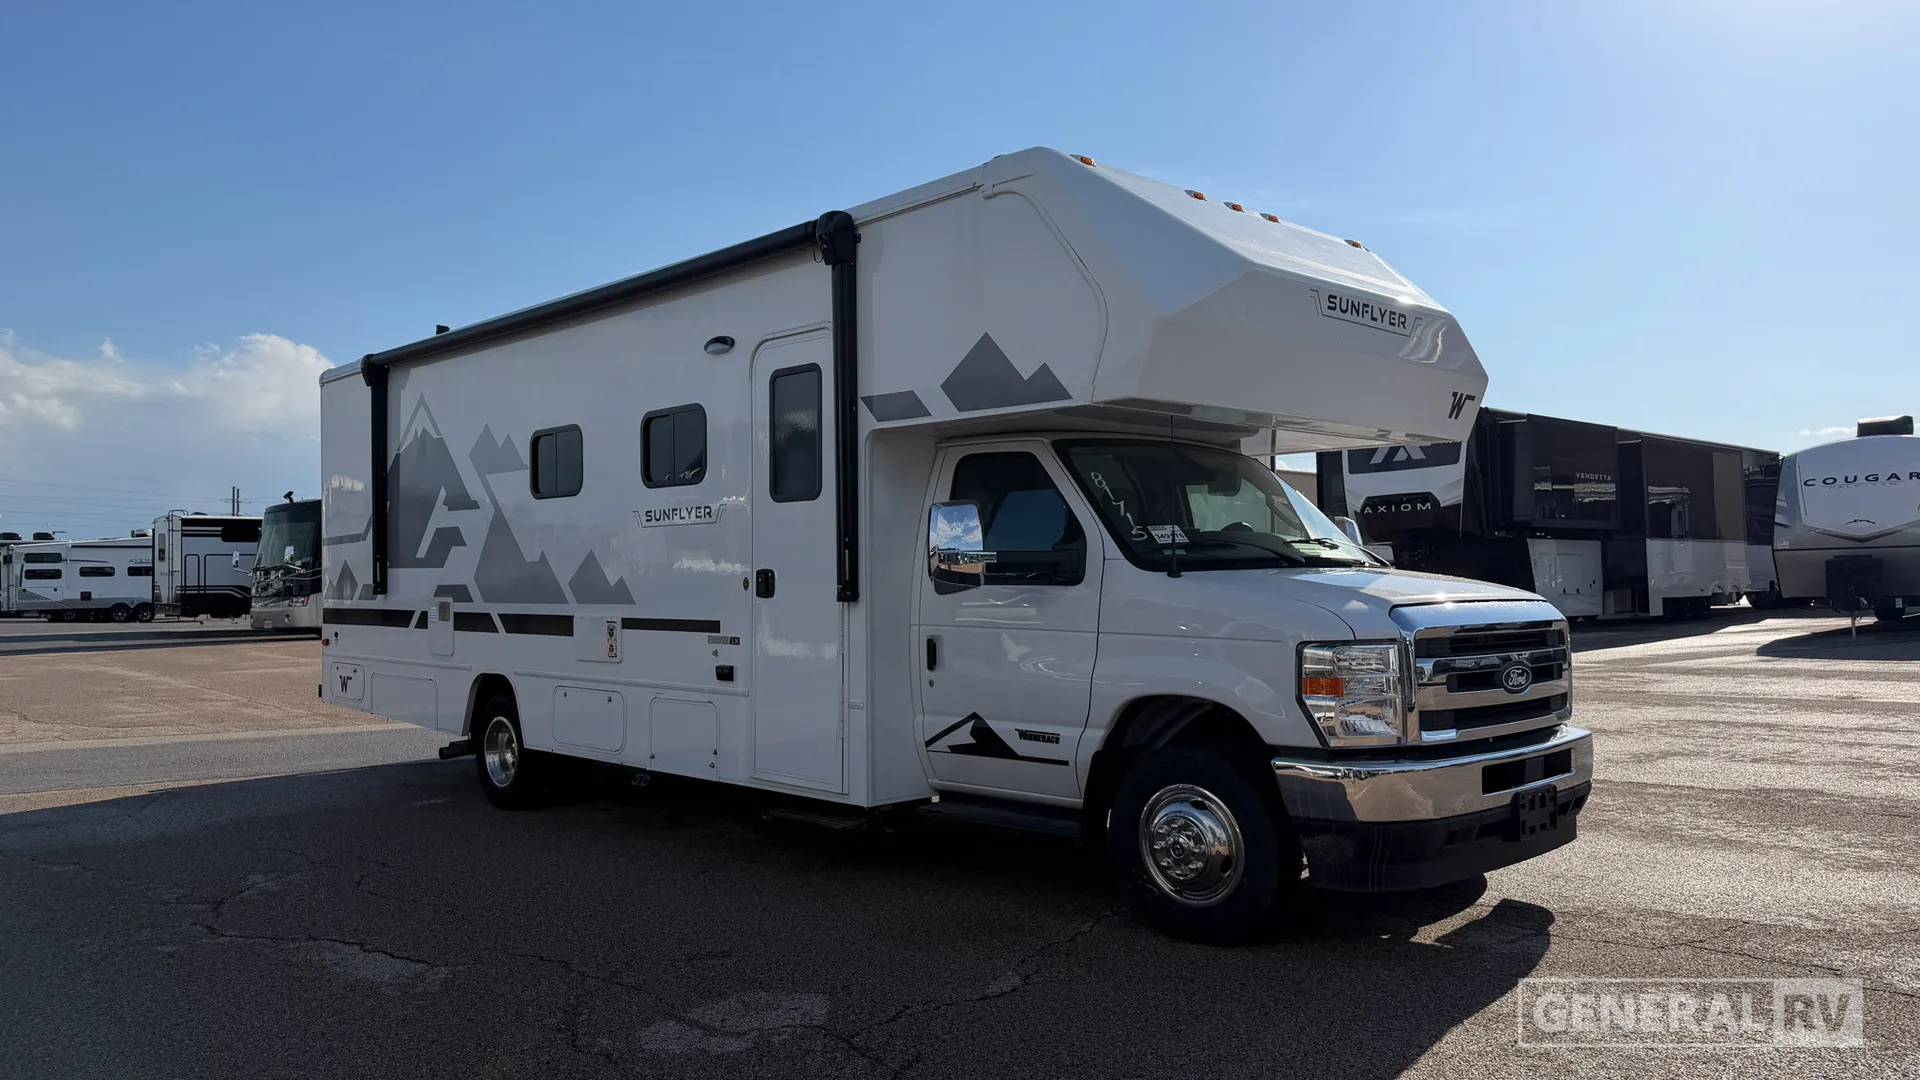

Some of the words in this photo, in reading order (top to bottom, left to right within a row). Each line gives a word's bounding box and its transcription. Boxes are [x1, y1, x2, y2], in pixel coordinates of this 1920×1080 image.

[1327, 294, 1407, 330] SUNFLYER
[1575, 472, 1612, 481] VENDETTA
[1803, 472, 1920, 487] COUGAR
[645, 505, 712, 522] SUNFLYER
[1363, 502, 1432, 515] AXIOM
[1508, 669, 1527, 686] Ford
